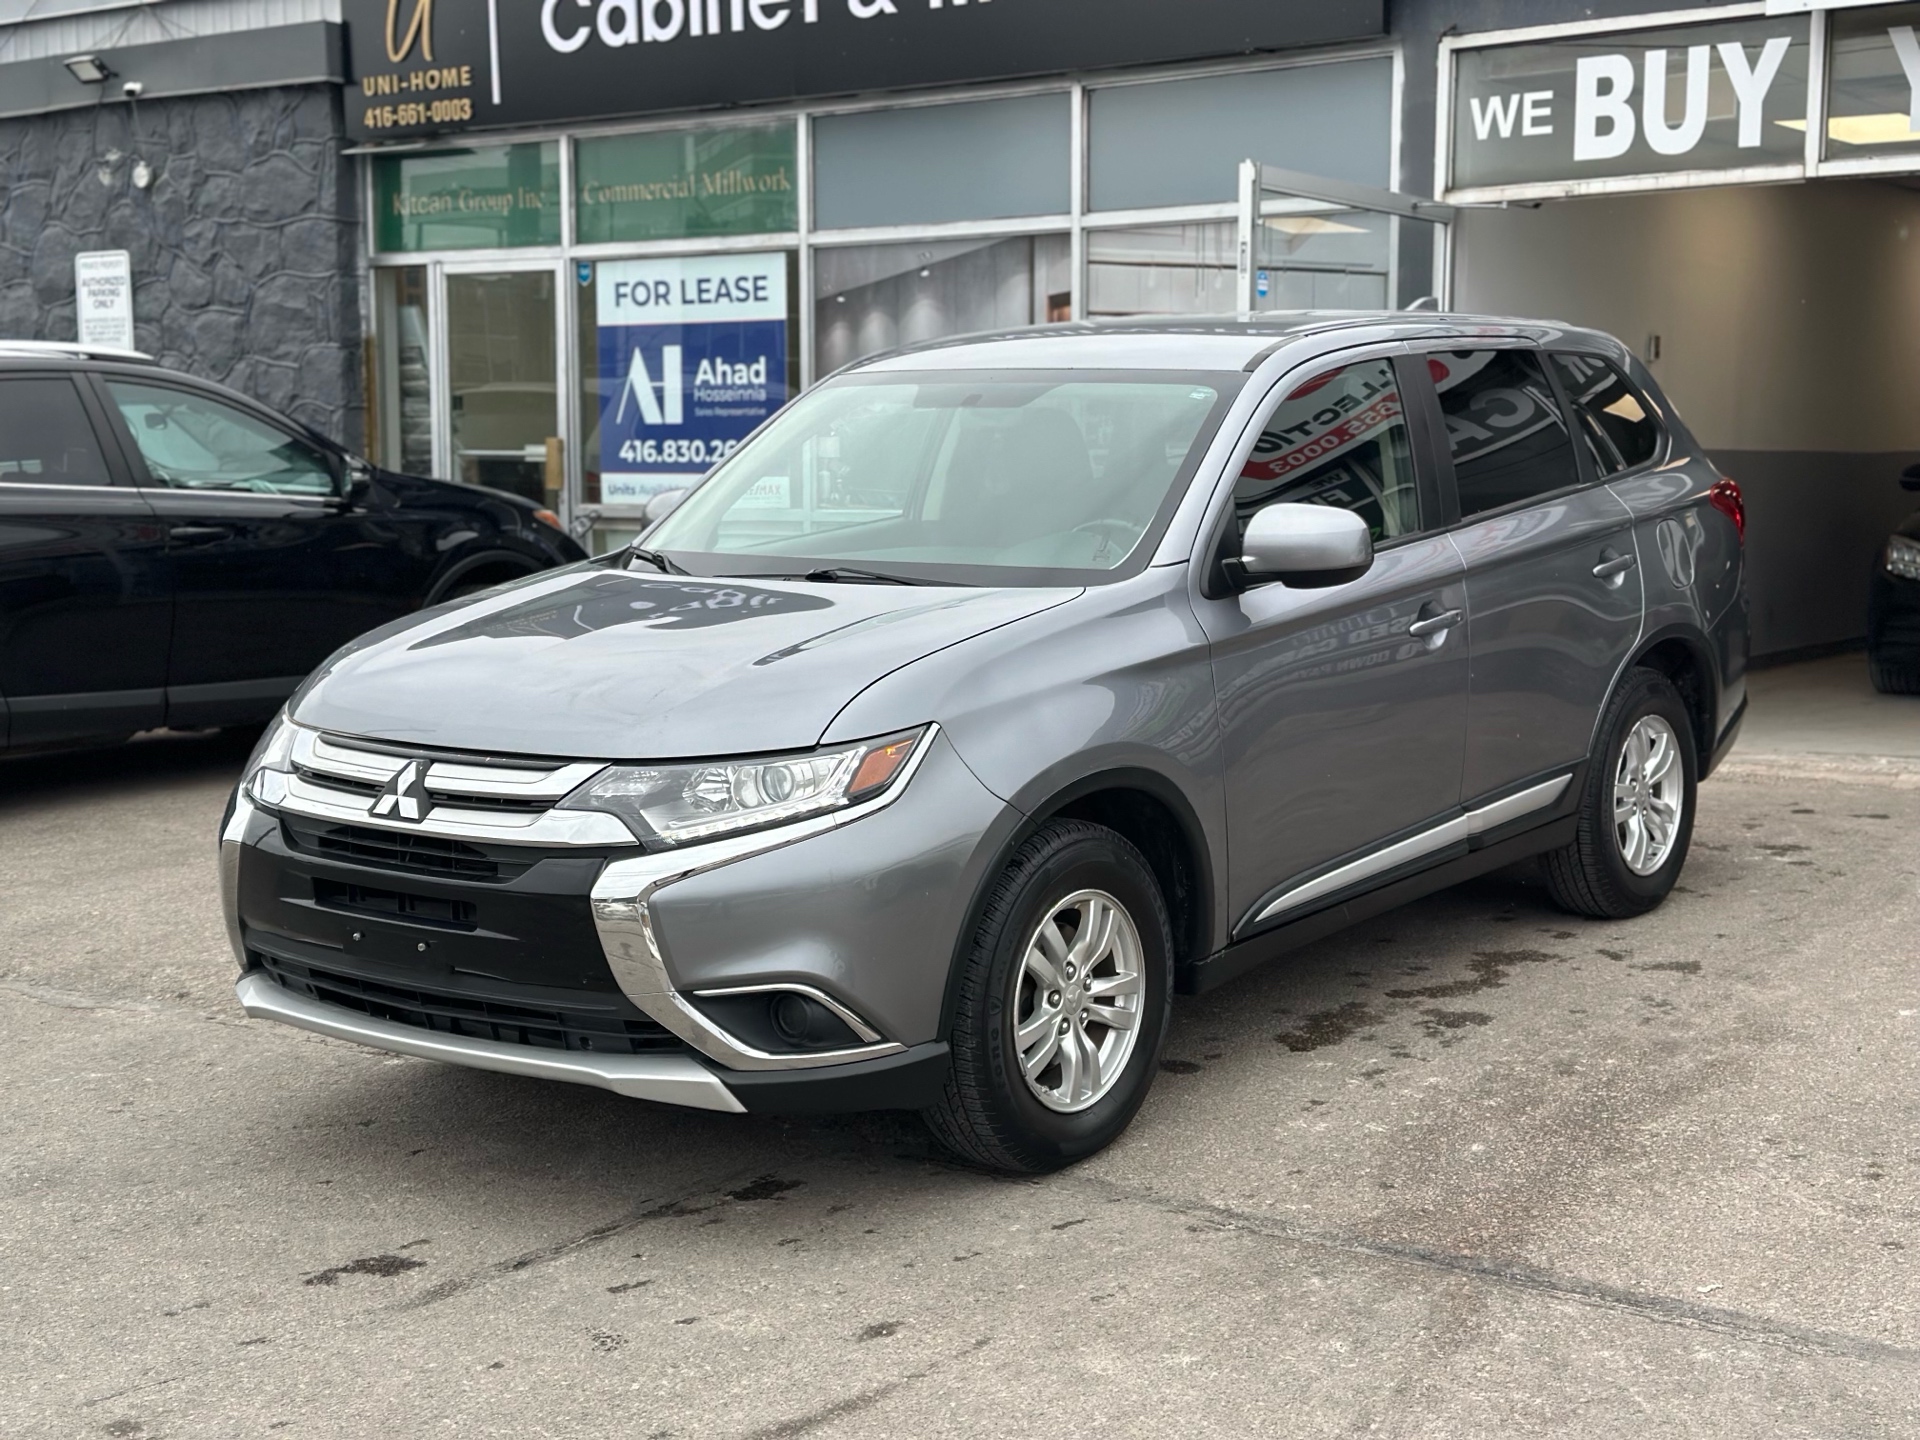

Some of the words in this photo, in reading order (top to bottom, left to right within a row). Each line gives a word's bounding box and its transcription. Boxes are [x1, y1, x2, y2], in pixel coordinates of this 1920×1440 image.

[363, 66, 471, 96] UNI-HOME
[363, 98, 472, 129] 416-661-0003
[1470, 90, 1553, 141] WE
[1574, 36, 1792, 162] BUY
[583, 174, 695, 204] Commercial
[703, 166, 790, 195] Millwork
[458, 187, 513, 216] Group
[615, 281, 670, 307] FOR
[680, 276, 769, 306] LEASE
[694, 355, 766, 386] Ahad
[607, 484, 636, 495] Units
